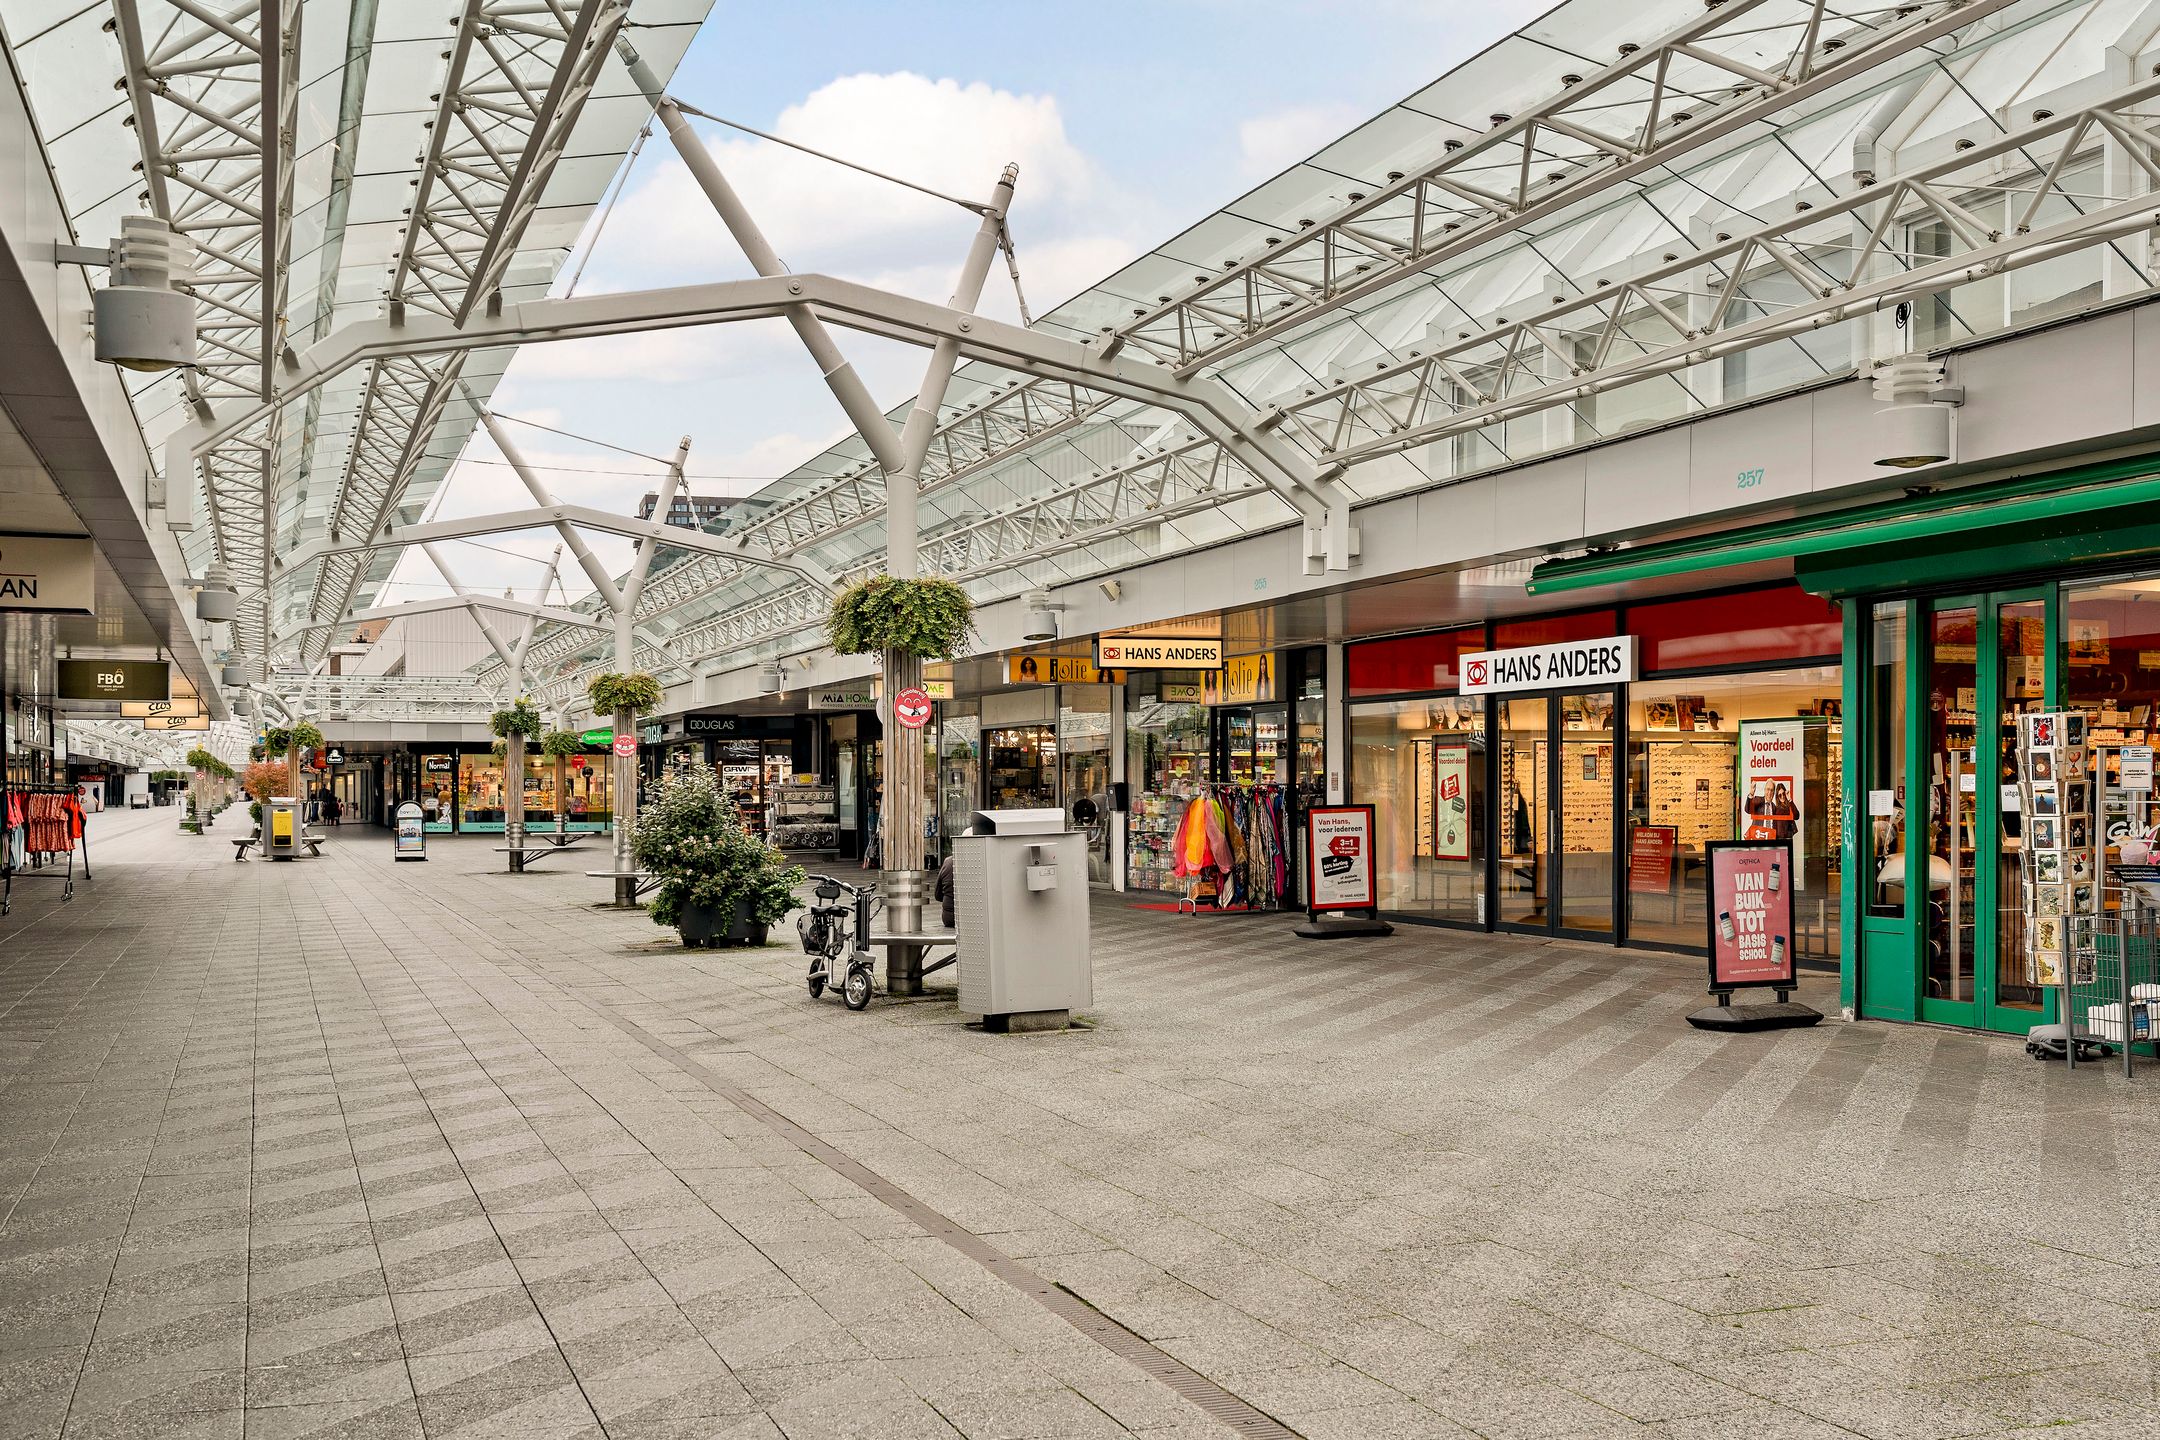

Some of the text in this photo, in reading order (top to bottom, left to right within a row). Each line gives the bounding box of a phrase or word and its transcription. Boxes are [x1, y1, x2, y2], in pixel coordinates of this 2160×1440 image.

[1737, 467, 1765, 489] 257
[1254, 578, 1267, 591] 255
[1125, 647, 1217, 660] HANS ANDERS
[1494, 645, 1621, 684] HANS ANDERS
[97, 673, 124, 685] FBO
[690, 720, 735, 730] DOUGLAS
[1750, 738, 1794, 752] Voordeel
[429, 760, 450, 770] Normal
[1750, 755, 1777, 768] delen
[2004, 789, 2020, 798] uitga
[1755, 829, 1770, 839] 3=1
[1734, 872, 1764, 891] VAN
[1735, 892, 1765, 910] BUIK
[1736, 910, 1766, 933] TOT
[1738, 933, 1767, 949] BASIS
[1739, 948, 1767, 961] SCHOOL
